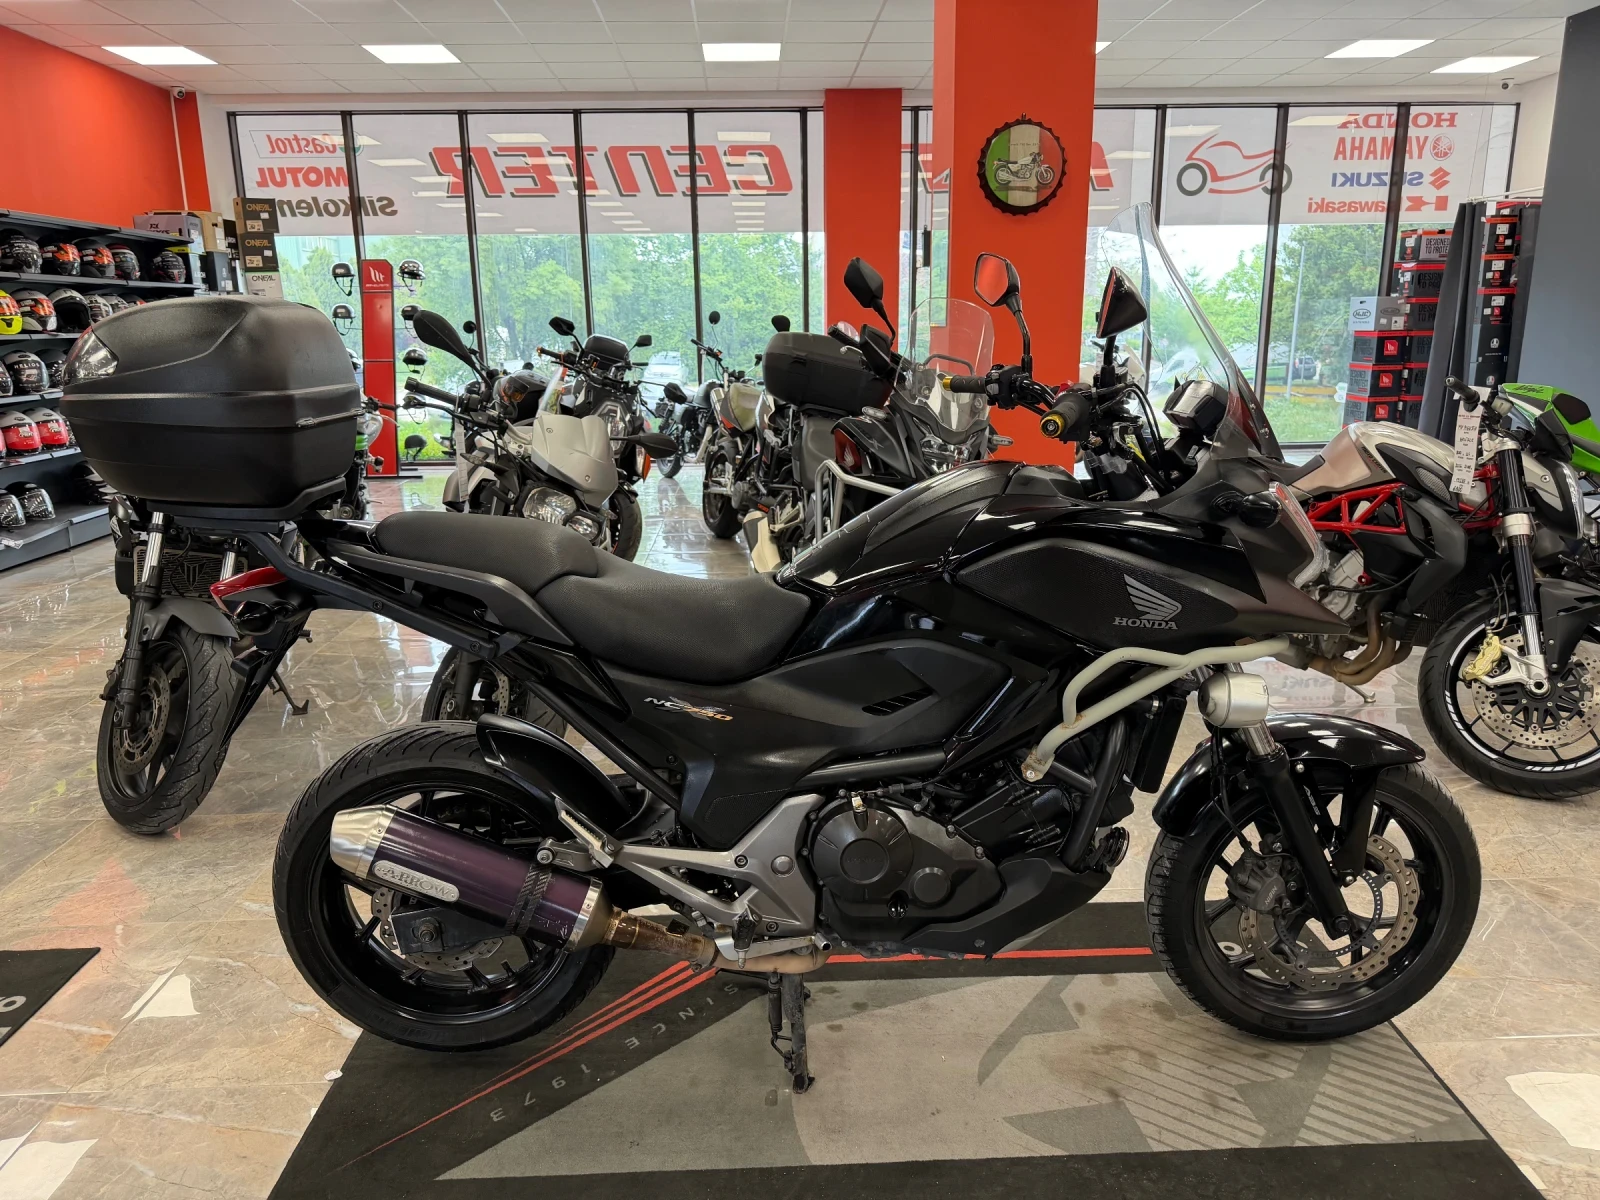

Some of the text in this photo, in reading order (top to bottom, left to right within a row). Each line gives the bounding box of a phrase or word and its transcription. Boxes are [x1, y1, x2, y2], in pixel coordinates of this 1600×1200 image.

[1112, 616, 1178, 630] HONDA
[385, 865, 451, 898] ARROW
[490, 983, 739, 1123] SINCE 1973
